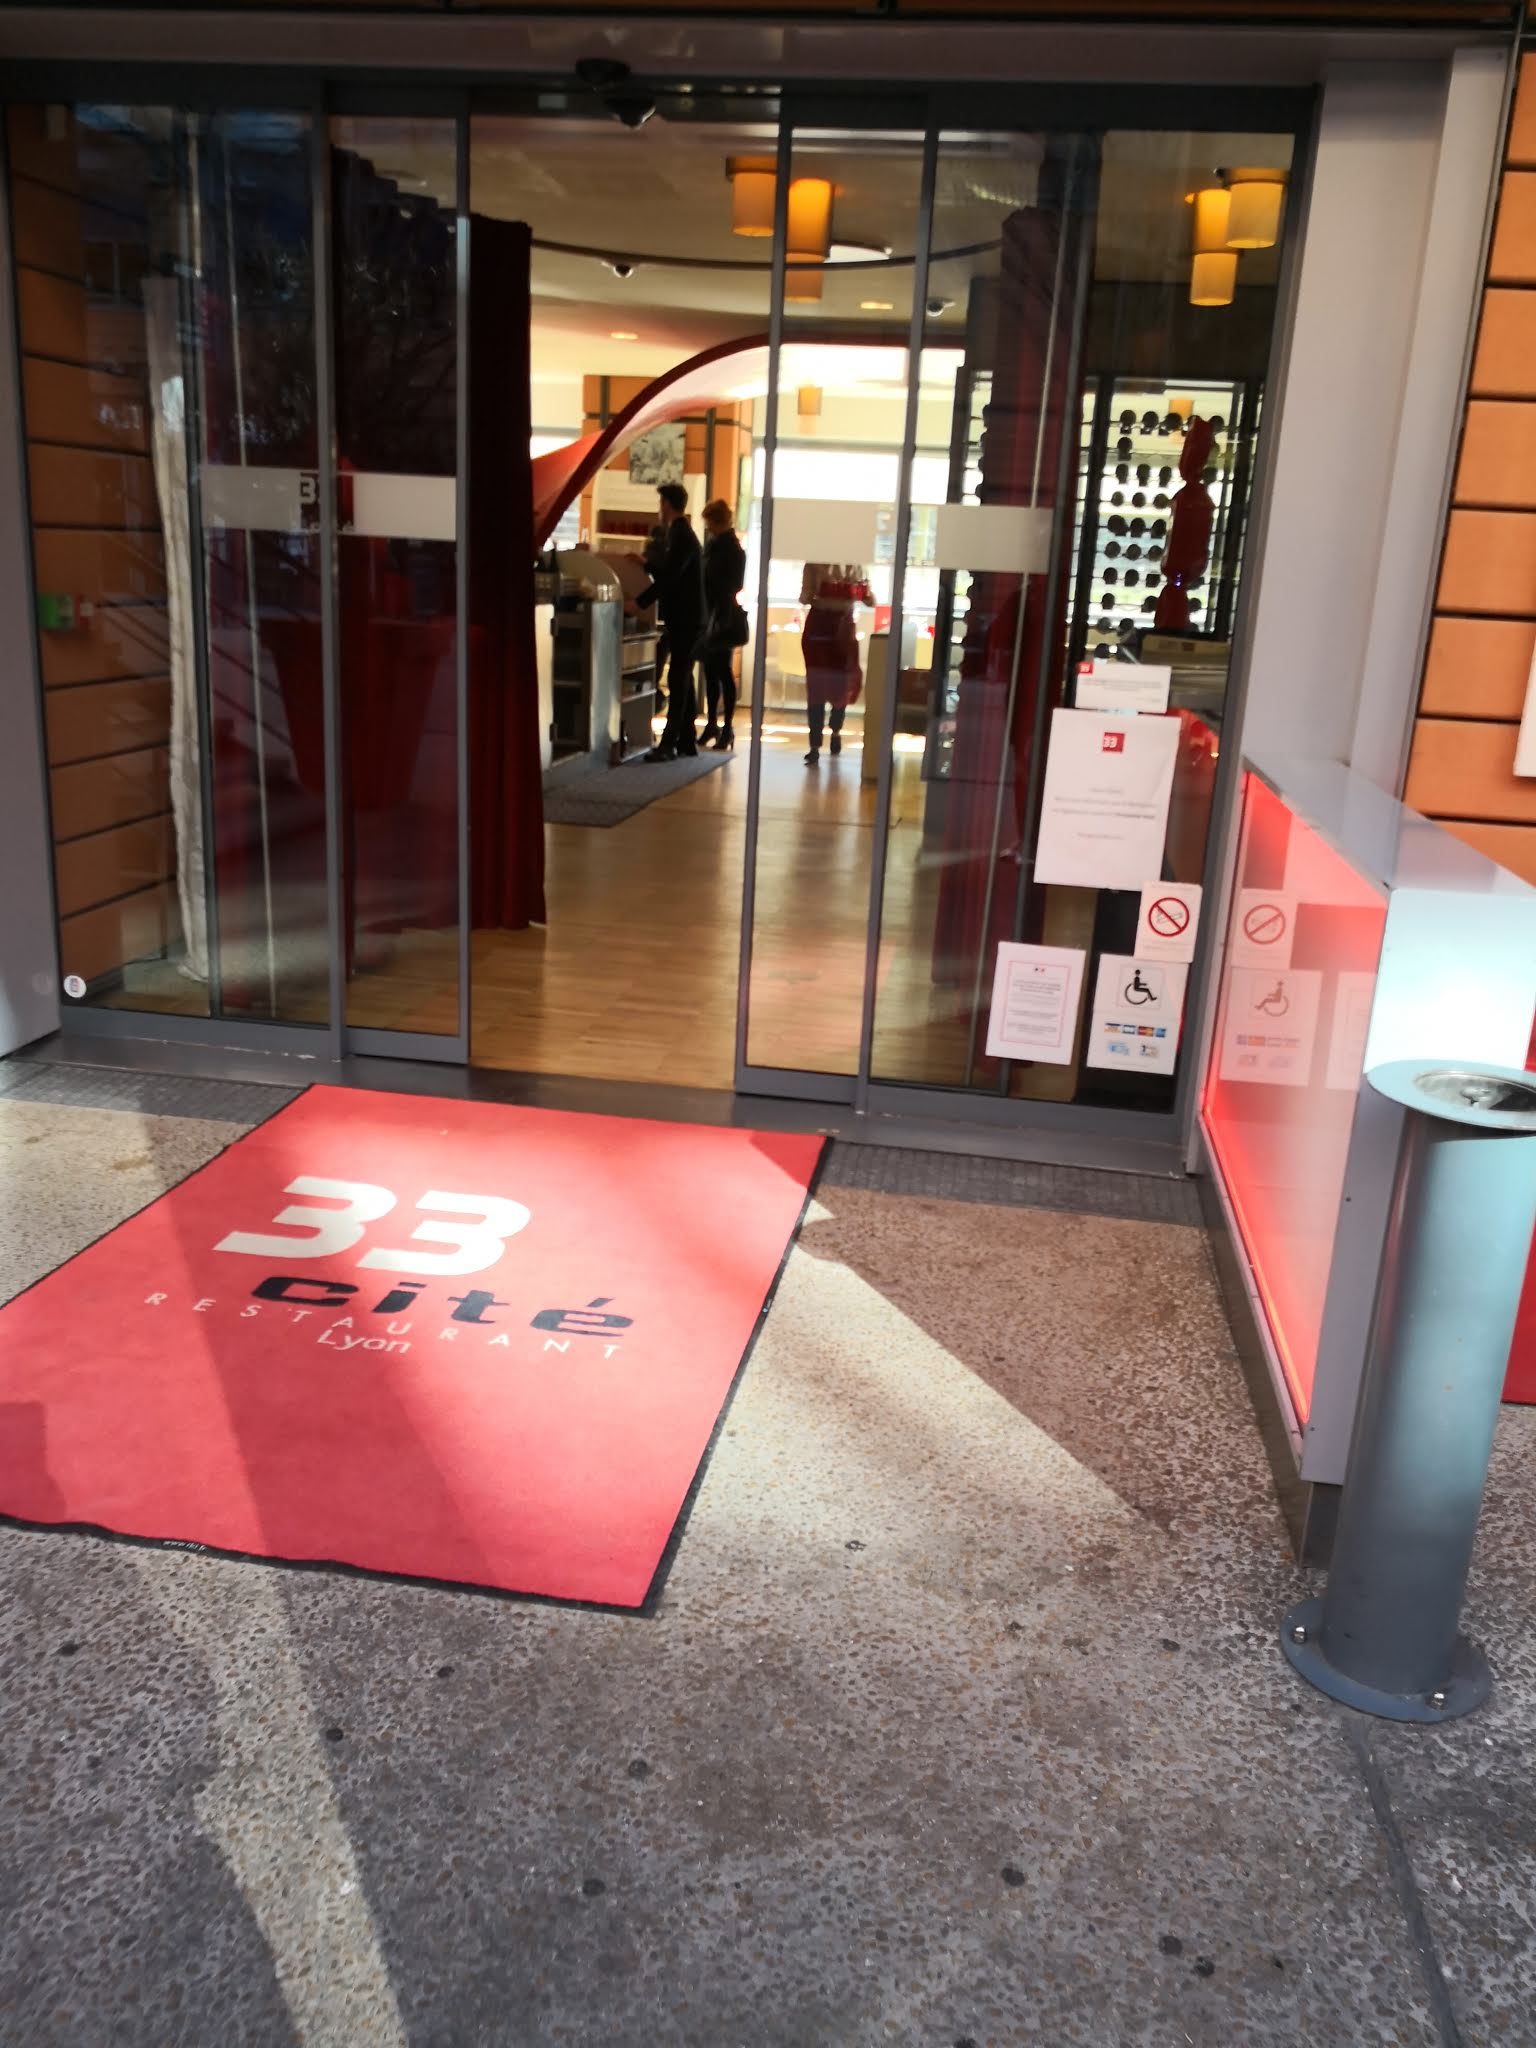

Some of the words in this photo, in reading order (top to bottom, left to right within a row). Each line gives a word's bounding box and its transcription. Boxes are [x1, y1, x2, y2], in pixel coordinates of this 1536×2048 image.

[213, 1176, 531, 1276] 33
[144, 1291, 622, 1360] RESTAURANT
[251, 1275, 635, 1337] cité
[317, 1326, 412, 1354] Lyon
